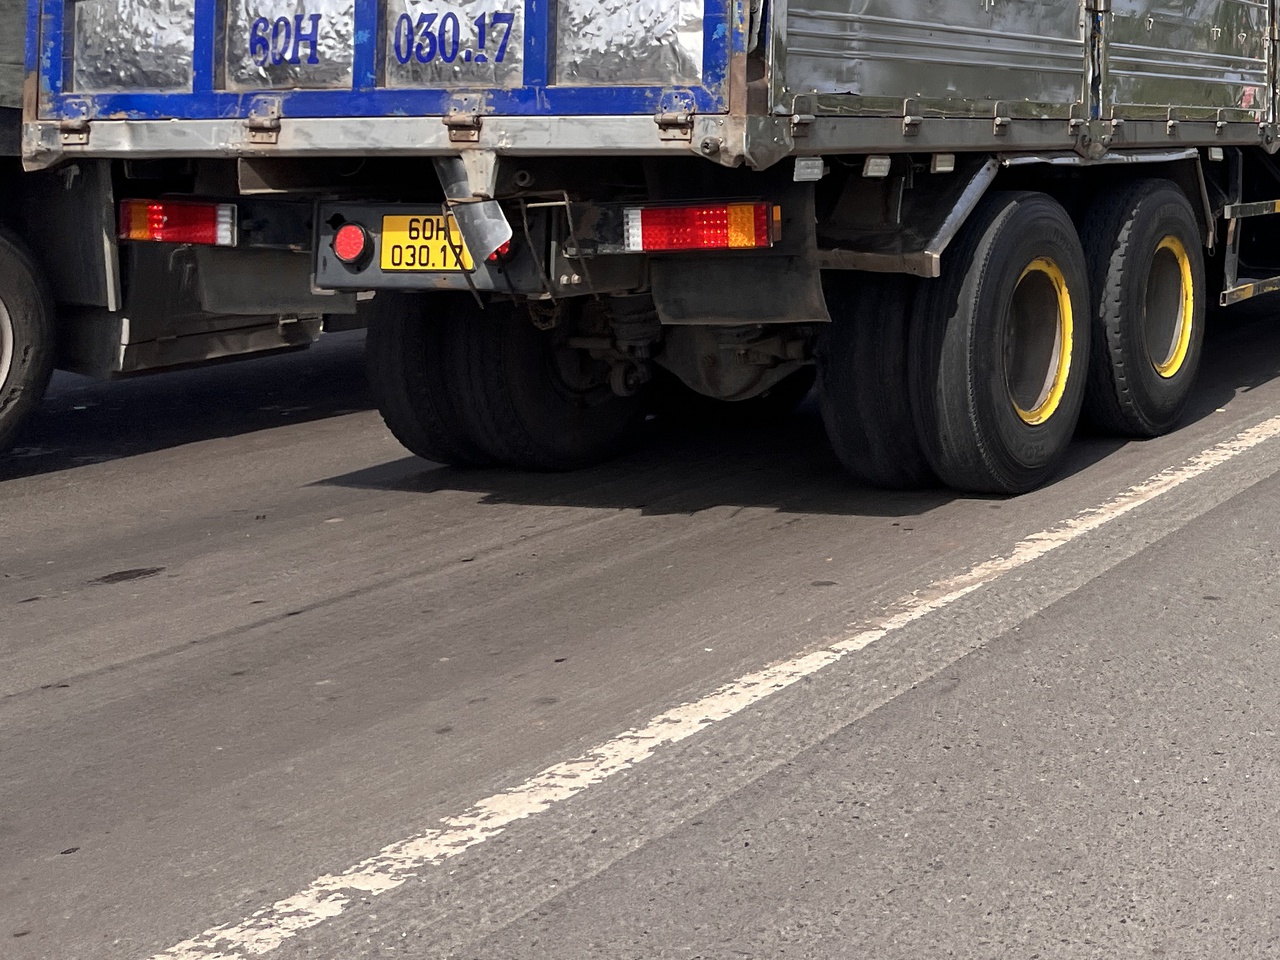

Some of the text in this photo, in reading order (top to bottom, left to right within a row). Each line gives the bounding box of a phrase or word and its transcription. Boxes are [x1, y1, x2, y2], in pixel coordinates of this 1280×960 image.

[249, 11, 515, 66] 60H 030.17
[408, 218, 447, 241] 60H
[391, 244, 463, 268] 030.17
